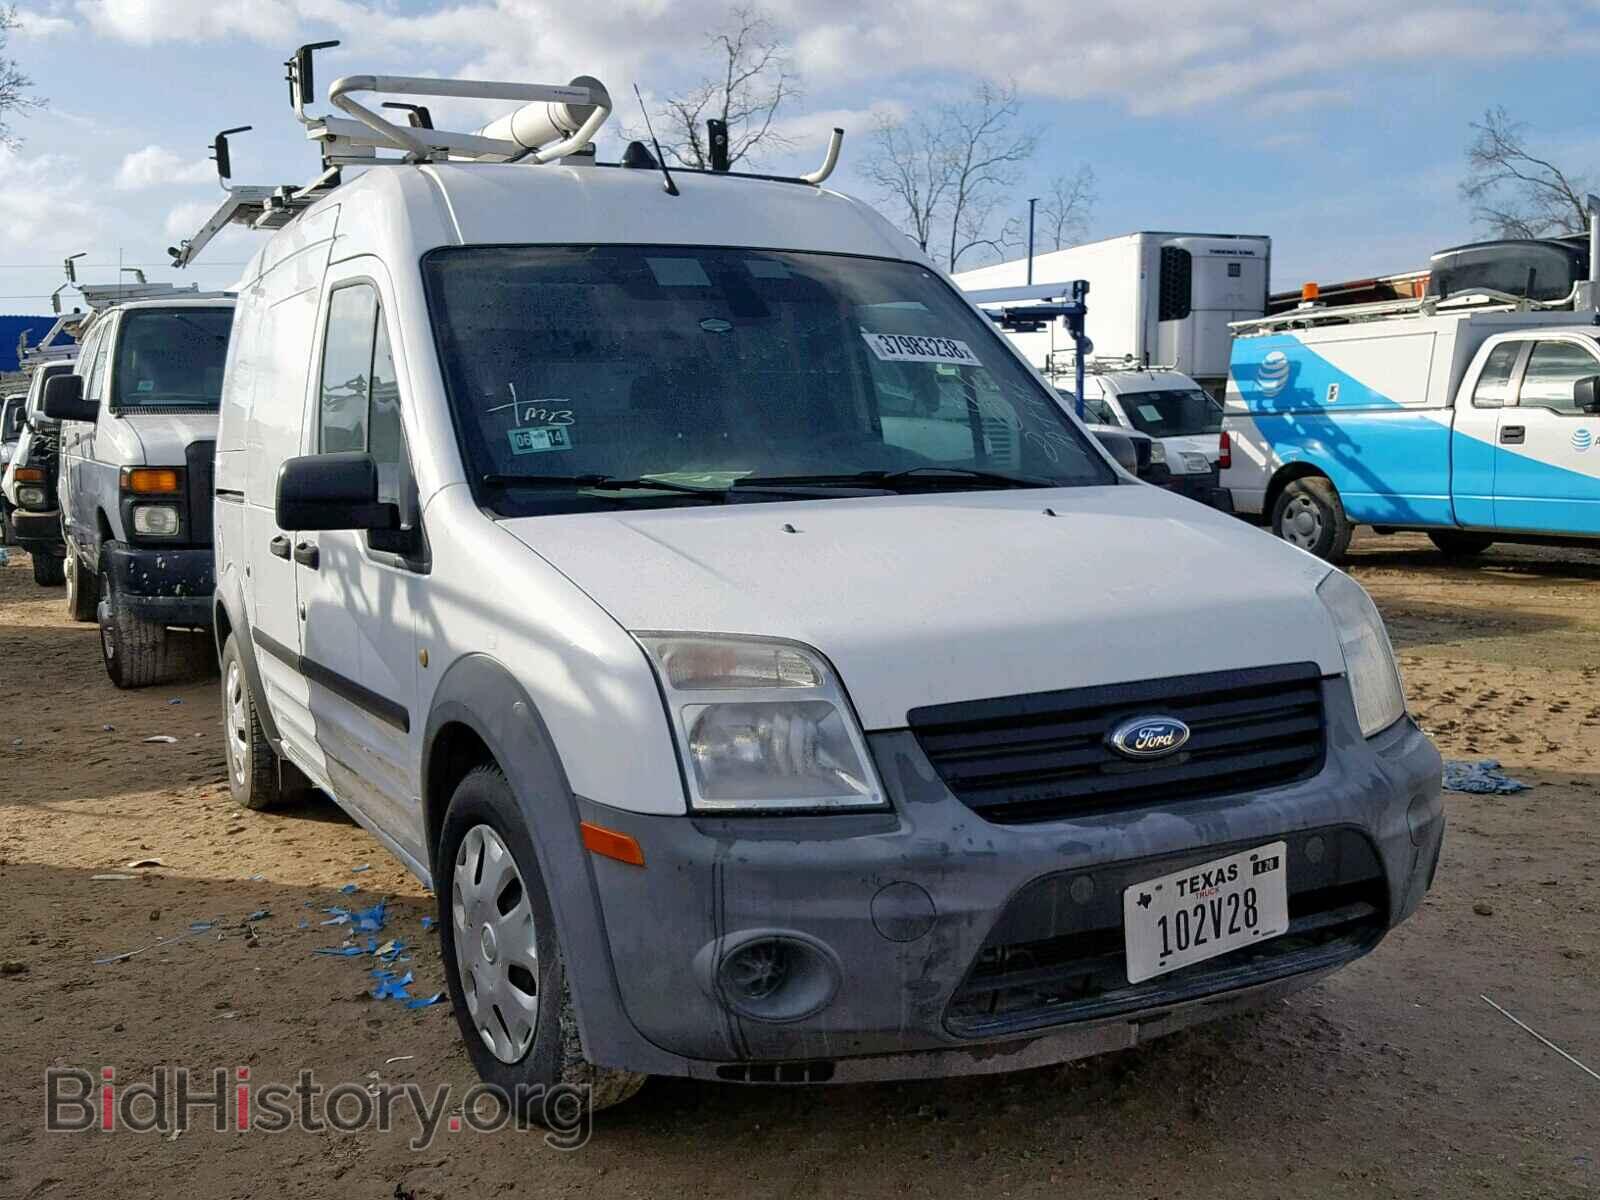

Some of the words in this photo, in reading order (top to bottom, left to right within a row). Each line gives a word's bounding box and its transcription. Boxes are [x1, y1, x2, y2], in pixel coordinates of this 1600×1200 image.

[878, 335, 965, 359] 37983238
[548, 430, 563, 444] 14
[1135, 725, 1175, 749] Ford
[1176, 863, 1239, 898] TEXAS
[1157, 887, 1258, 958] 102V28
